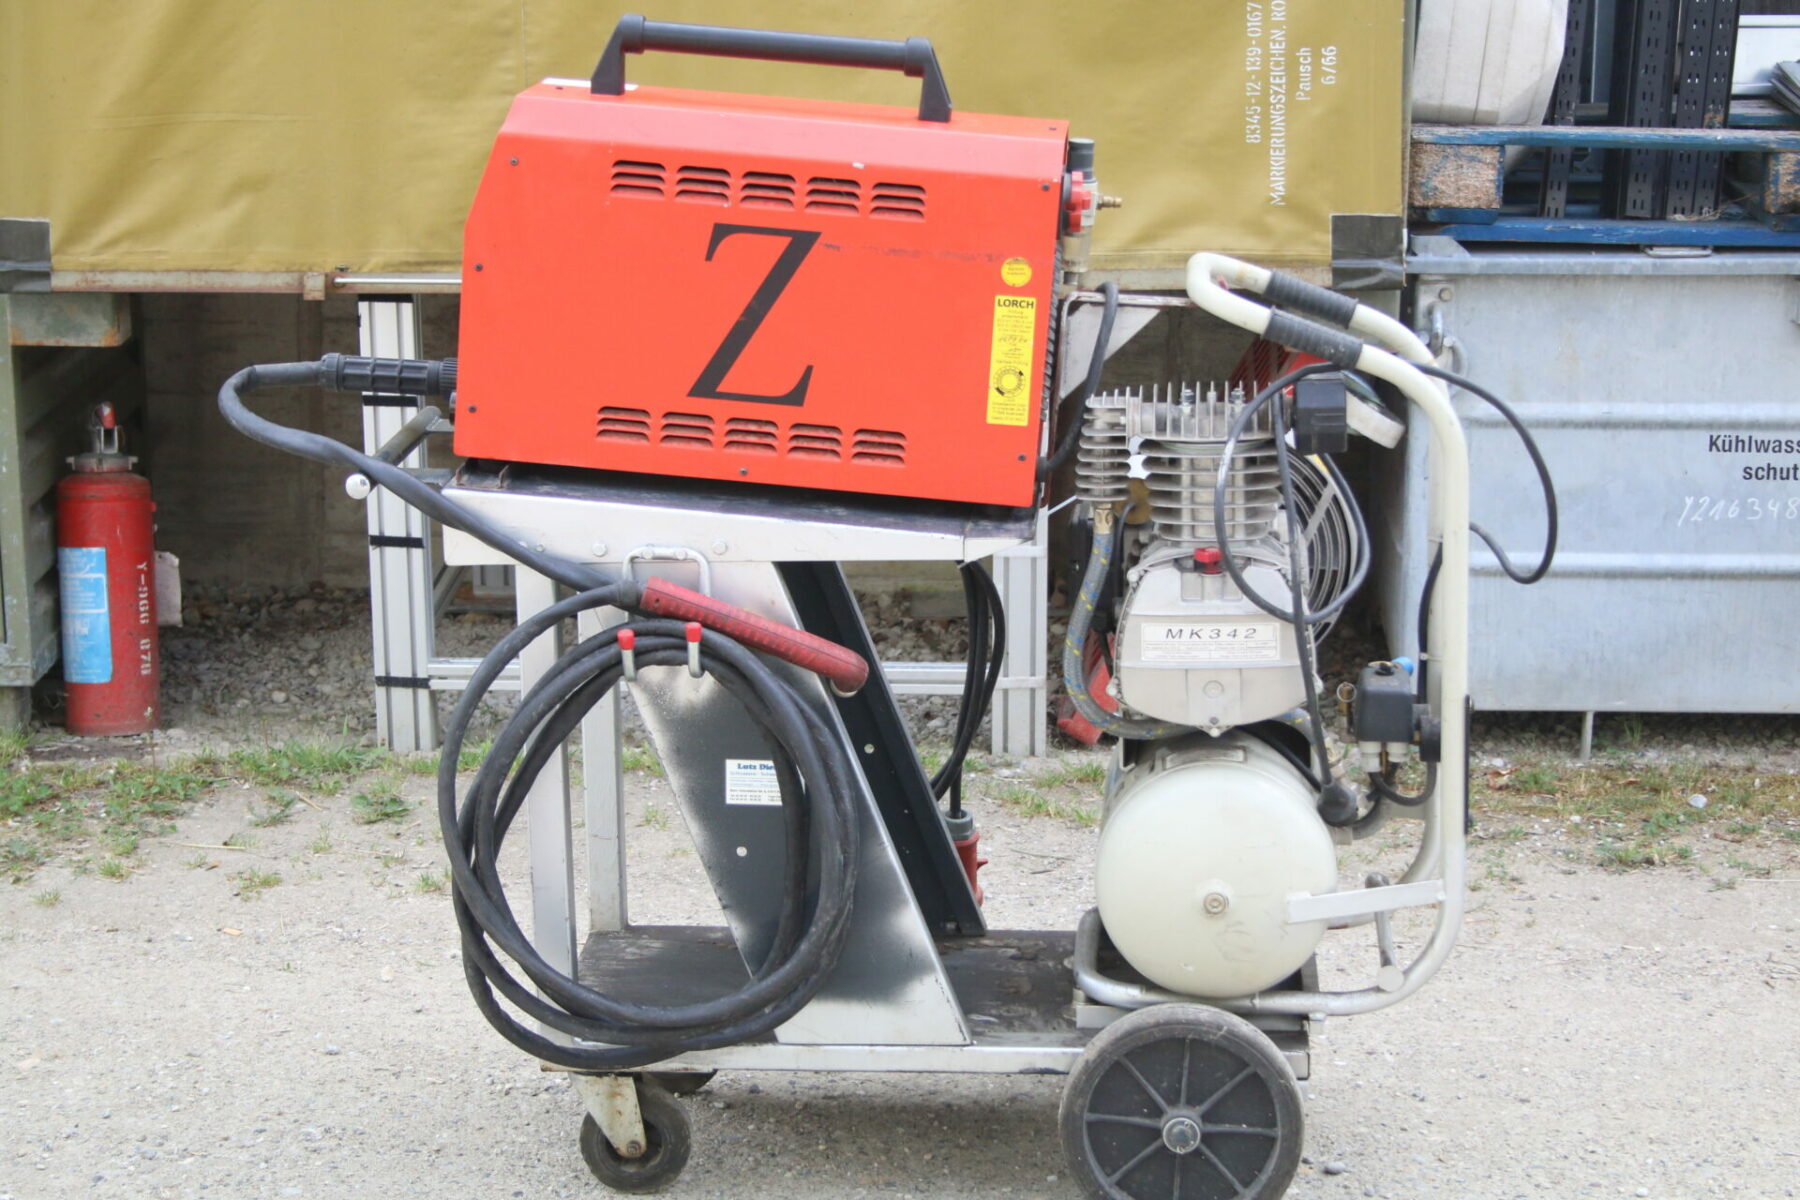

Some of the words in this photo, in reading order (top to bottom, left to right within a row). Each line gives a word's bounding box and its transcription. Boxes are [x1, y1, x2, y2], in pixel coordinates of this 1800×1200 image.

[1296, 47, 1312, 100] Pausch
[686, 222, 822, 407] Z
[997, 297, 1035, 310] LORCH
[1165, 628, 1257, 640] MK342
